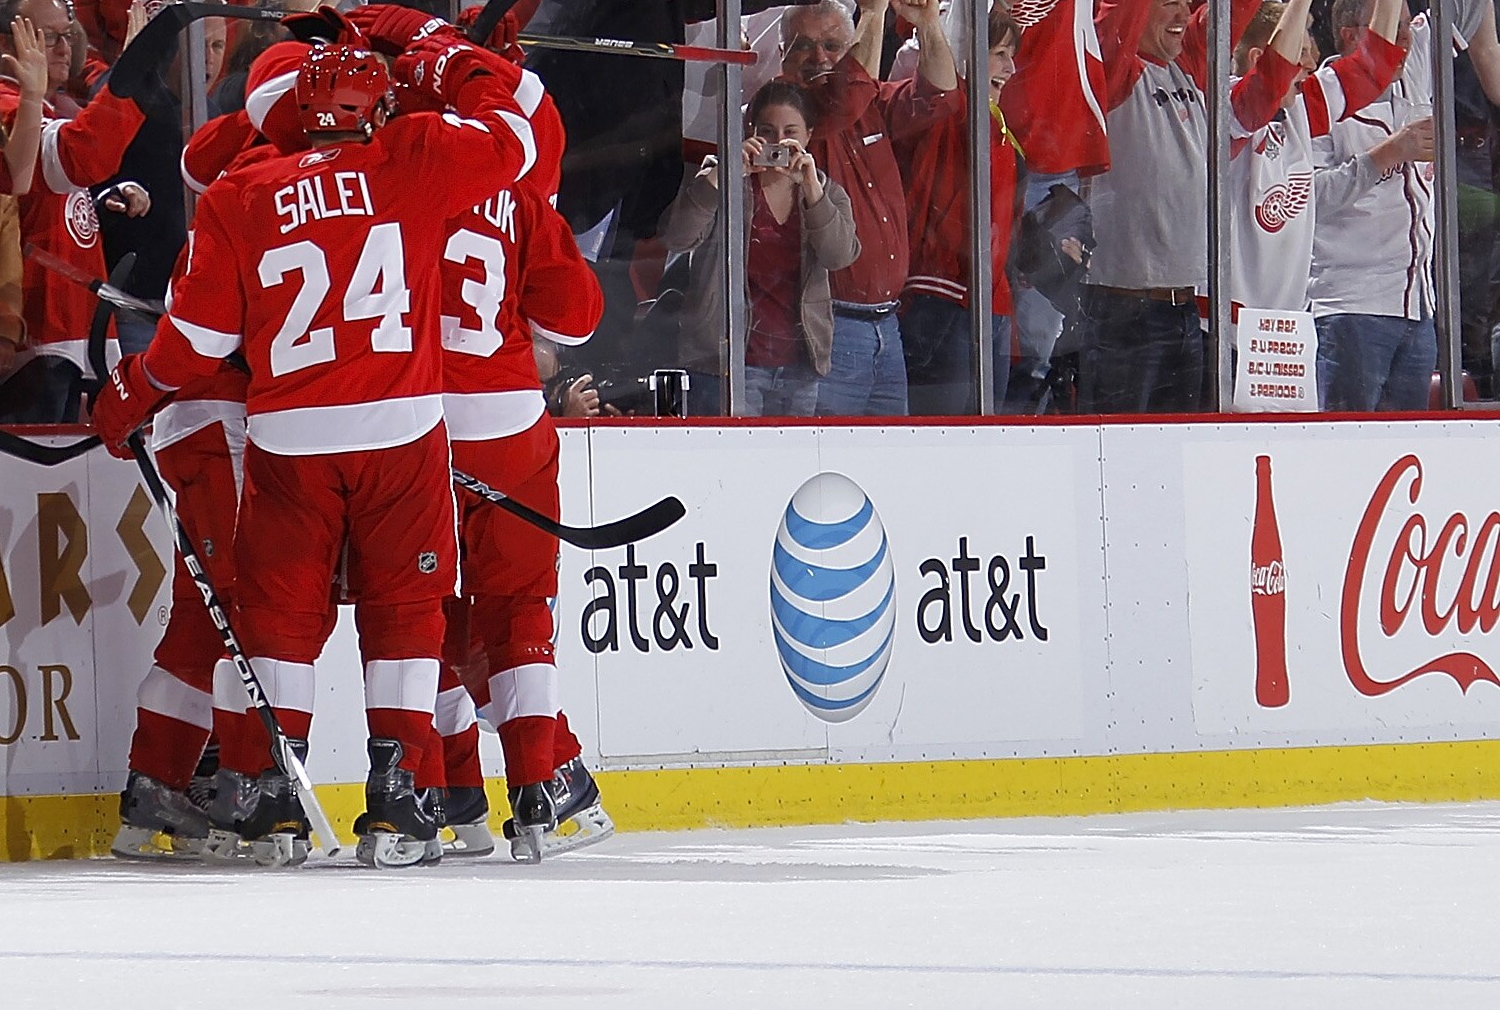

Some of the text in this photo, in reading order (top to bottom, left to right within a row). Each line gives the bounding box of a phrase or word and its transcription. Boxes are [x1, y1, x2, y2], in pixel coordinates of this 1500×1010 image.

[316, 112, 336, 127] 24
[273, 171, 374, 235] SALEI
[257, 222, 413, 378] 24
[190, 555, 266, 708] EASTON
[581, 541, 720, 654] at&t
[916, 535, 1049, 645] at&t
